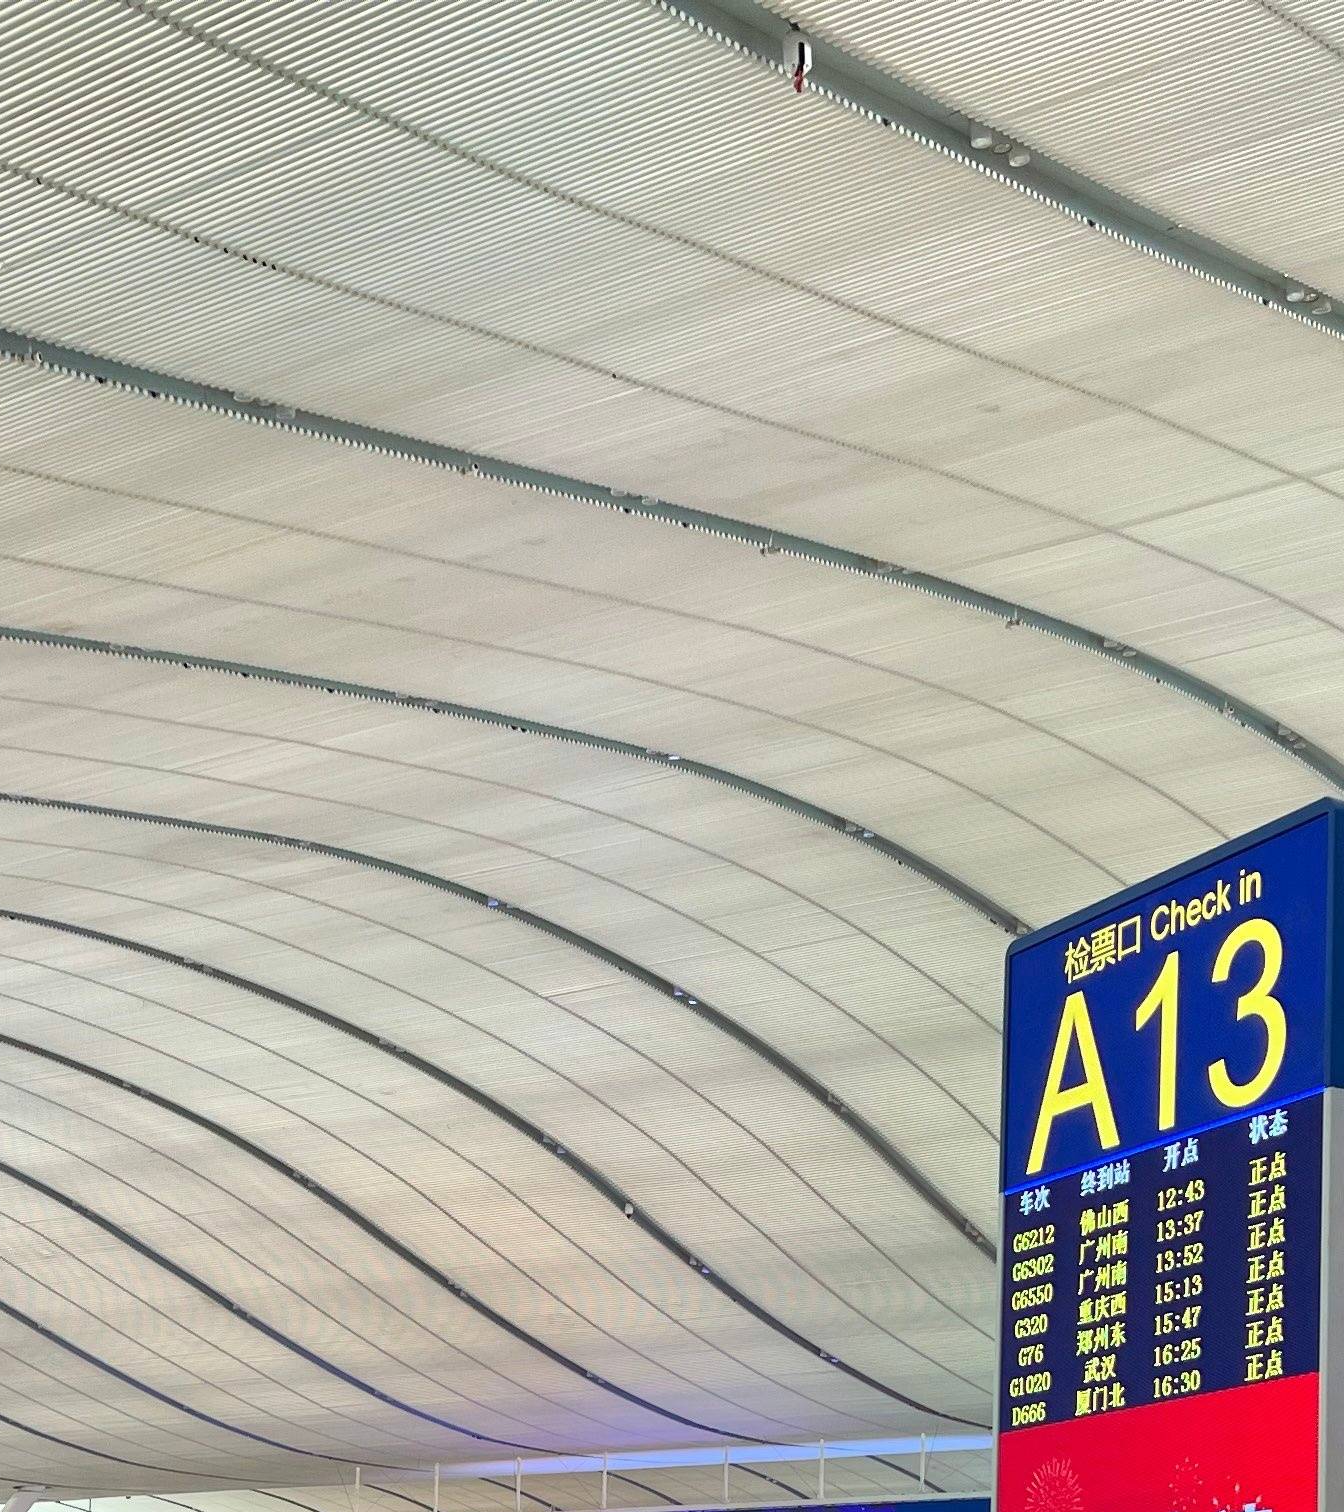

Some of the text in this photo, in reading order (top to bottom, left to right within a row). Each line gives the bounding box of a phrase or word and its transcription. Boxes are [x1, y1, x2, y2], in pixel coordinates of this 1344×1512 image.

[1064, 869, 1261, 984] 检票口 Check in
[1026, 918, 1287, 1175] A13
[1012, 1151, 1287, 1254] G6212 佛山西 12:43 正点
[1019, 1108, 1288, 1216] 车次 终到站 开点 状态
[1011, 1217, 1286, 1311] G6550 广州南 13:52 正点
[1012, 1184, 1286, 1283] G6302 广州南 13:37 正点
[1014, 1249, 1285, 1339] G320 重庆西 15:13 正点
[1018, 1282, 1285, 1367] G76 郑州东 15:47 正点
[1009, 1315, 1284, 1398] G1020 武汉 16:25 正点
[1012, 1349, 1284, 1427] D666 厦门北 16:30 正点
